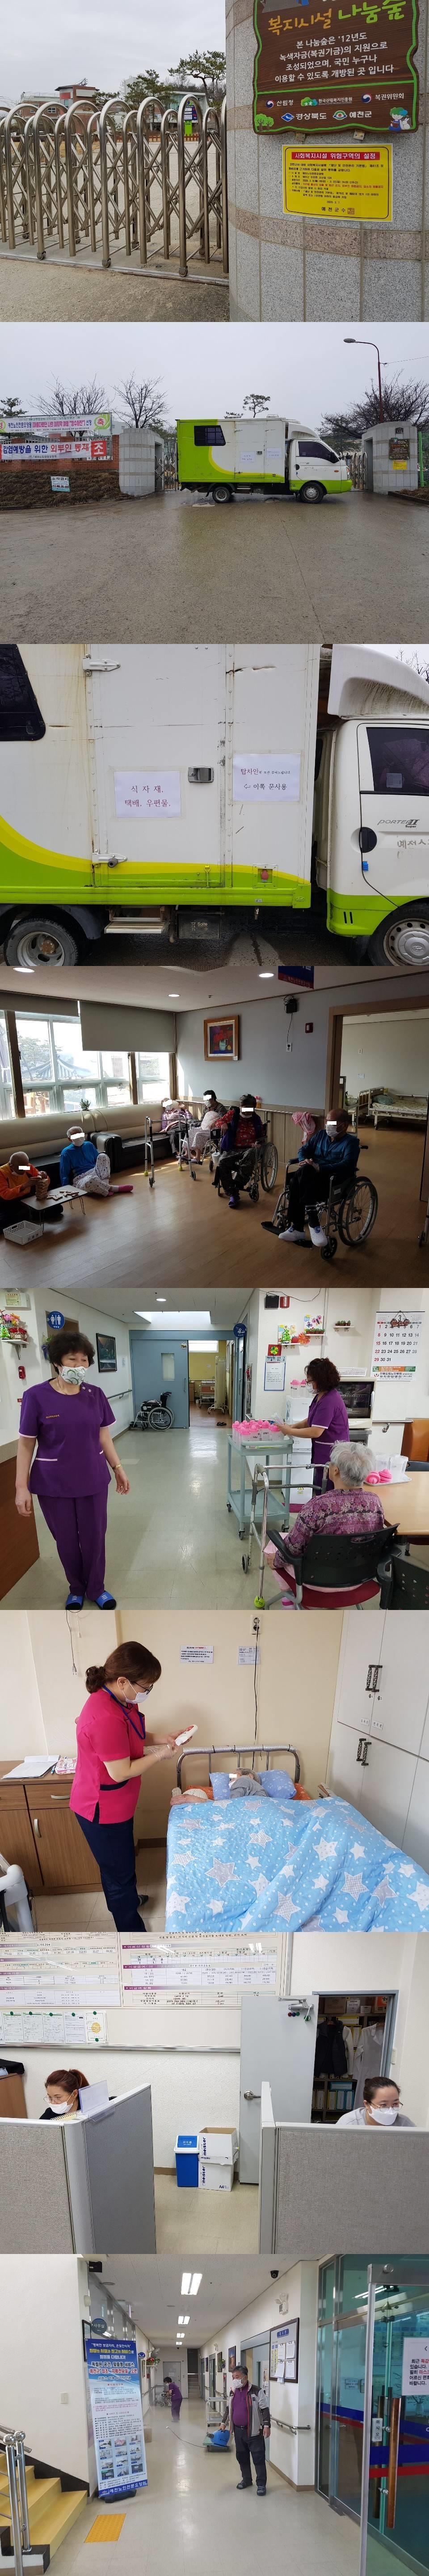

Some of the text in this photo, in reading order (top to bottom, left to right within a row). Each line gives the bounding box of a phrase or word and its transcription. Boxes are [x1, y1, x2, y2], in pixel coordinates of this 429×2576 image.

[268, 0, 406, 35] 복지시설 나눔숲
[296, 32, 367, 49] 본 나눔숲은 '12년도
[280, 41, 388, 62] 녹색자금(복권기금)의 지원으로
[286, 55, 378, 71] 조성되었으며, 국민 누구나
[275, 64, 395, 82] 이용할 수 있도록 개방된 곳 입니다
[349, 110, 372, 119] 예천군
[3, 442, 104, 455] 감염예방을 위한 외부인 통제 조
[109, 2481, 147, 2493] 예천노인전문요양원
